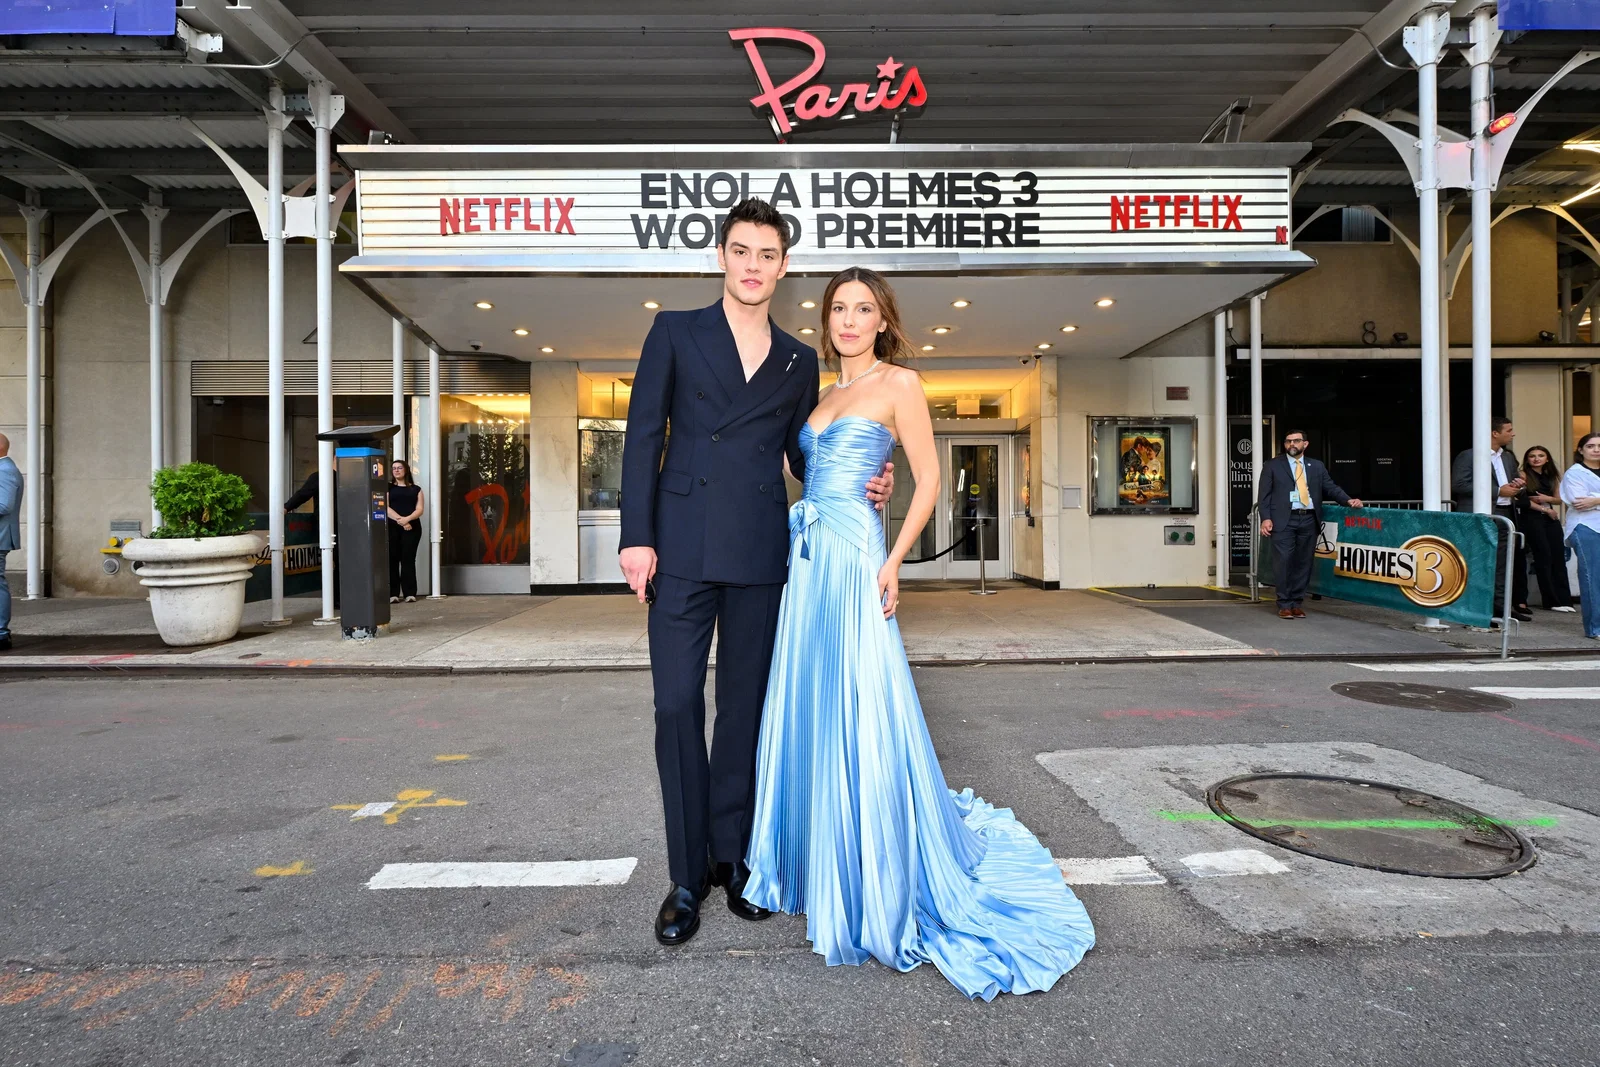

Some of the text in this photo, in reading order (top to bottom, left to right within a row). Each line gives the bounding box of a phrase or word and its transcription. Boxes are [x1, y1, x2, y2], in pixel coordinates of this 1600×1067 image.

[728, 27, 927, 134] Paris
[811, 171, 1001, 208] HOLMES
[1012, 171, 1039, 207] 3
[440, 197, 576, 236] NETFLIX
[630, 212, 1040, 249] WOD PREMIERE
[1110, 195, 1243, 232] NETFLIX
[1275, 225, 1287, 244] N
[1362, 321, 1377, 345] 8
[1344, 515, 1383, 530] NETFLIX
[287, 545, 322, 571] HOLME
[1340, 546, 1443, 594] HOLMES 3
